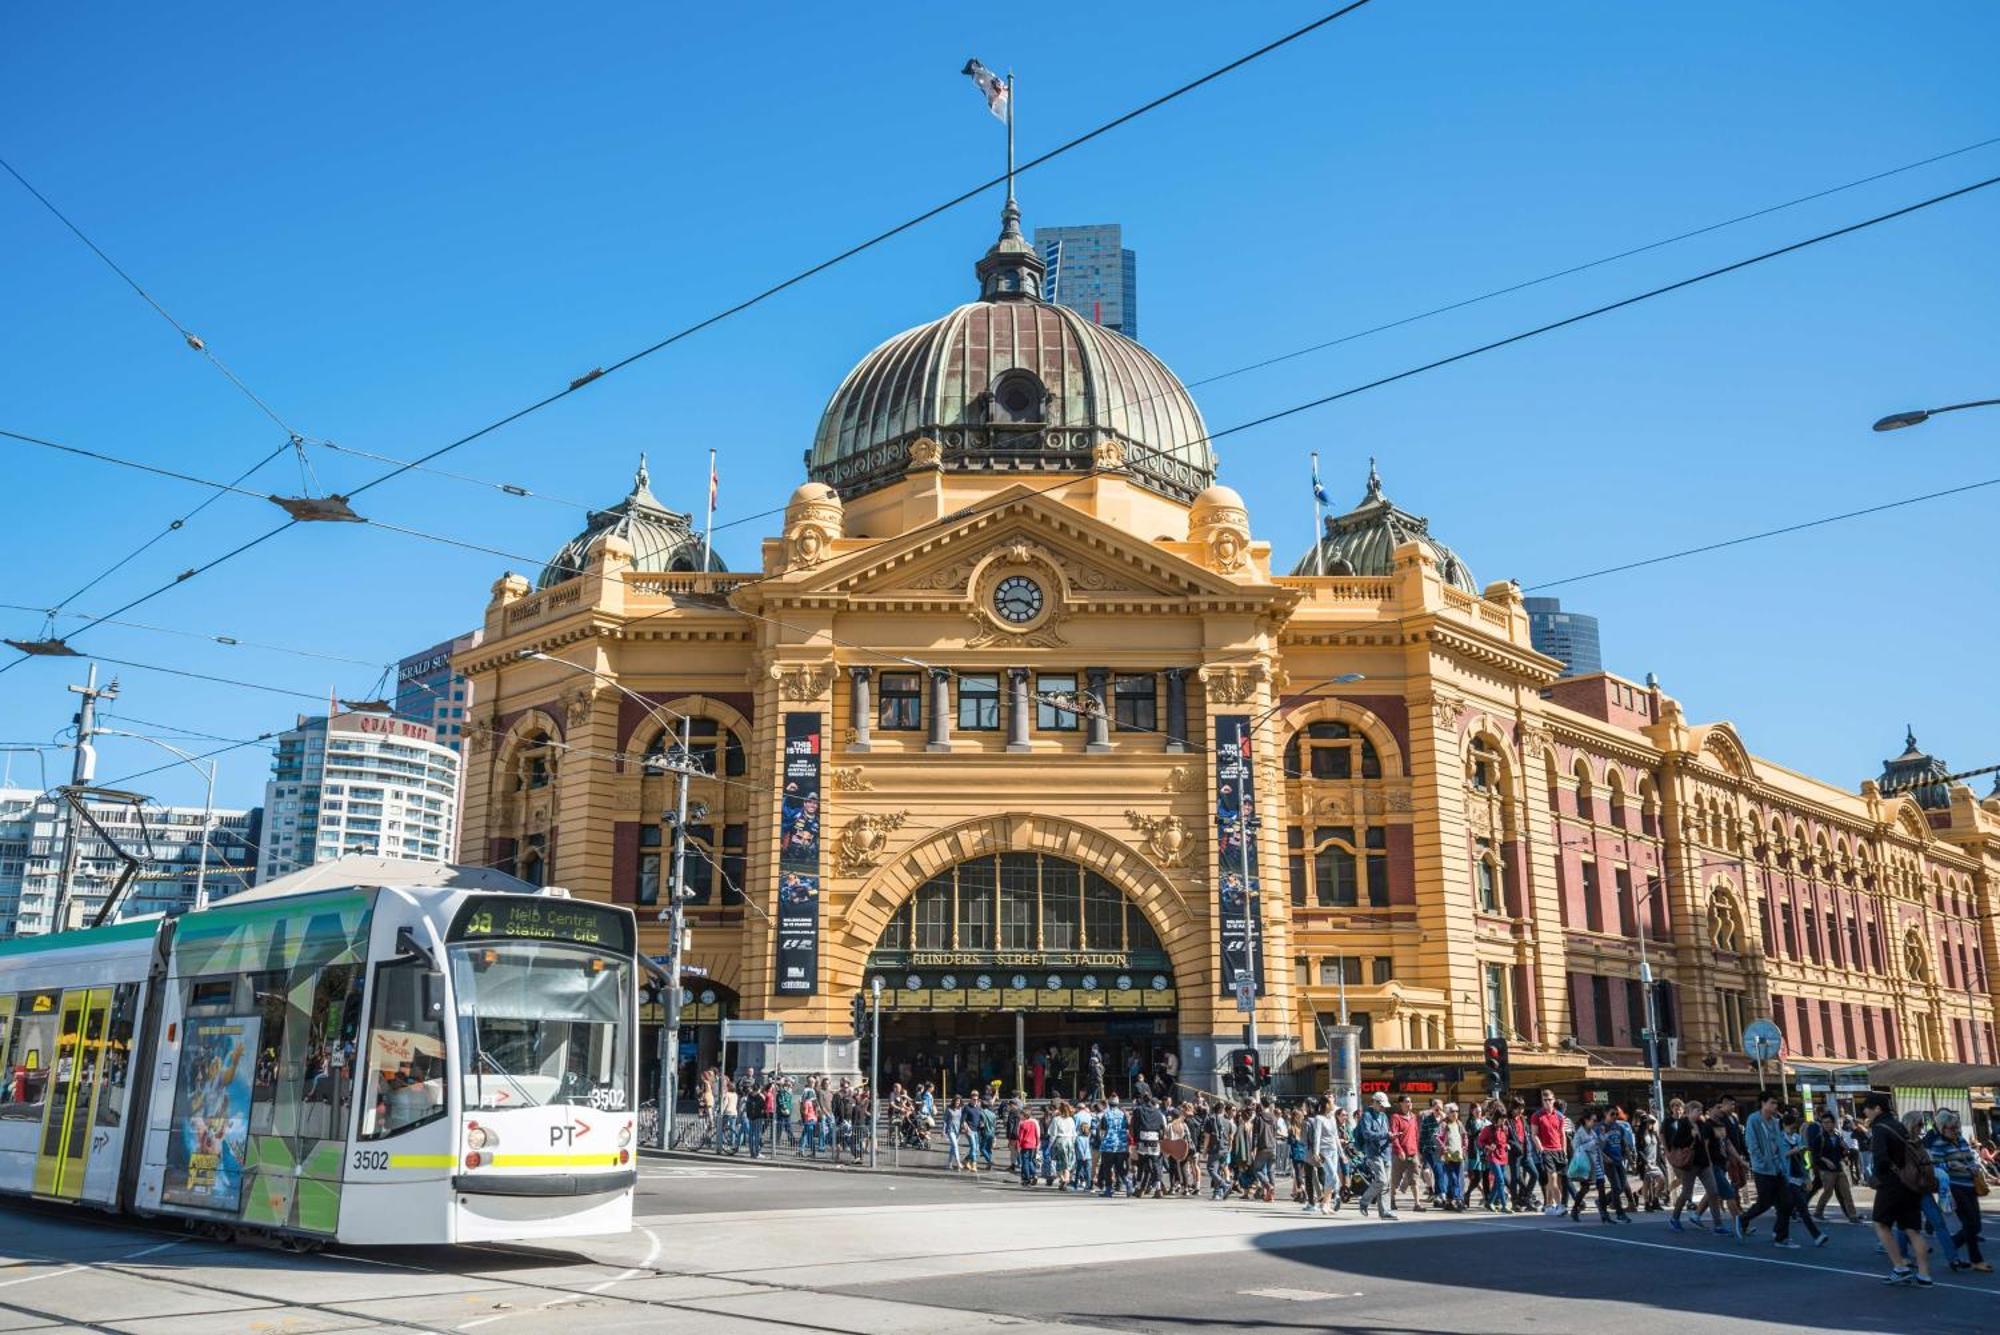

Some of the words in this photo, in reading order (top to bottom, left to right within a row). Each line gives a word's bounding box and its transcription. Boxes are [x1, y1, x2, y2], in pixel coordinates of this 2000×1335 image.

[361, 717, 396, 734] QUAY
[402, 722, 428, 741] WEST
[547, 910, 597, 928] Central
[505, 922, 555, 938] Station
[573, 928, 599, 943] City
[912, 953, 980, 966] FLINDERS
[997, 953, 1048, 966] STREET
[1064, 952, 1127, 966] STATION
[1361, 1081, 1391, 1092] CITY
[592, 1088, 626, 1108] 3502
[353, 1150, 389, 1170] 3502
